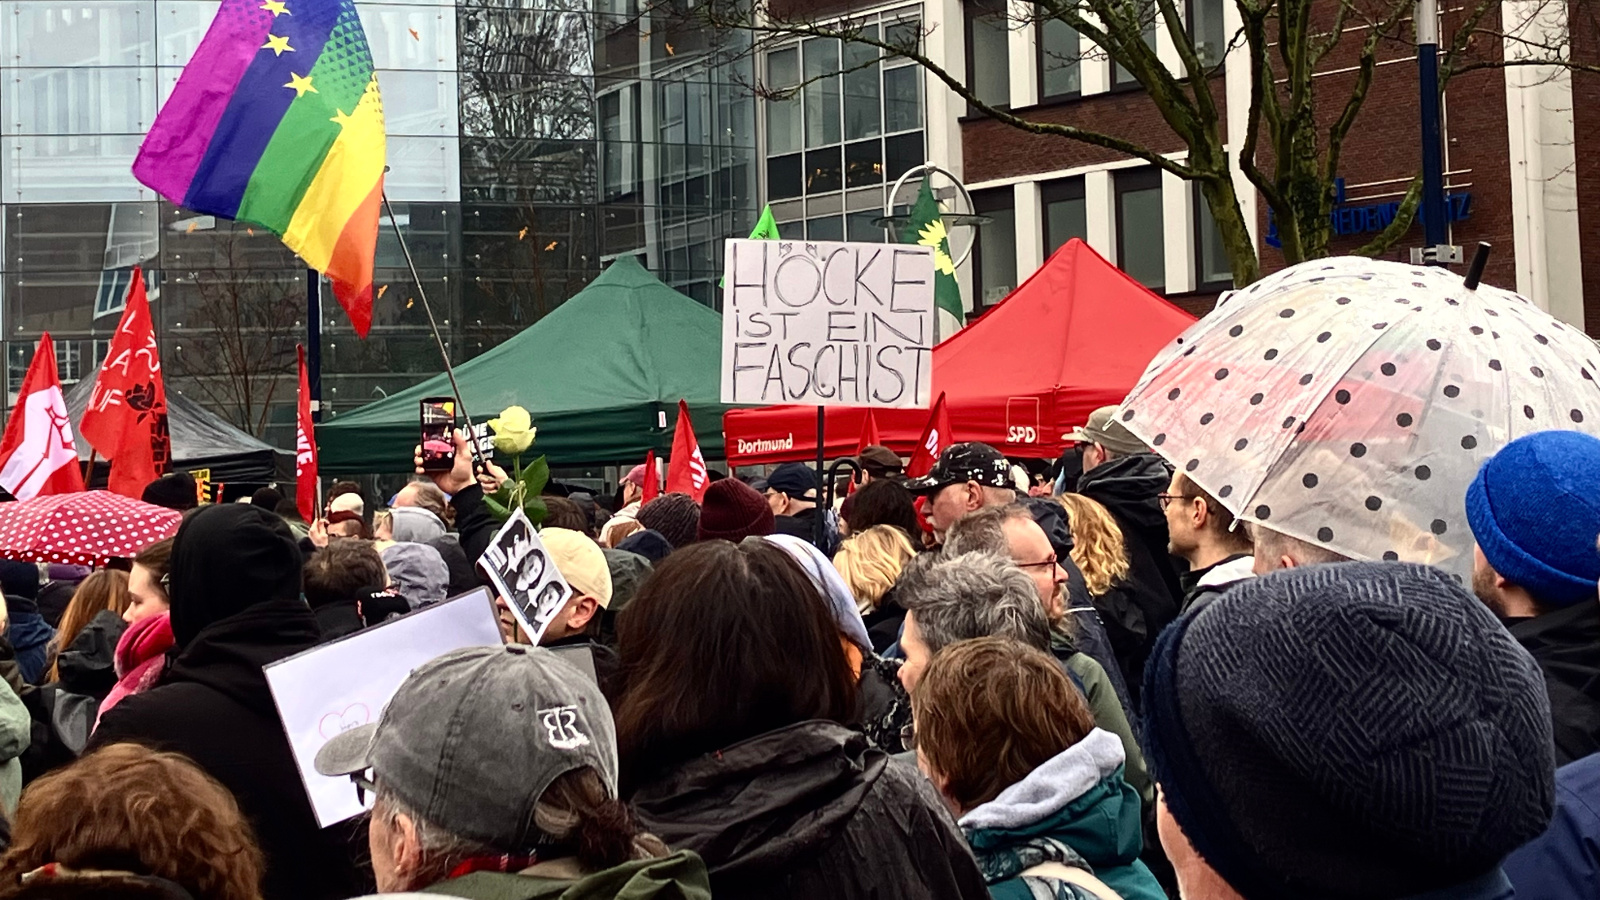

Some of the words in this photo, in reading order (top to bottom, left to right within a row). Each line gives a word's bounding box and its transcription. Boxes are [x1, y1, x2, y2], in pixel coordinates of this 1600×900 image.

[733, 242, 930, 313] HÖCKE
[827, 311, 924, 345] EIN
[732, 342, 932, 405] FASCHIST
[737, 432, 793, 454] Dortmund
[1007, 426, 1036, 443] SPD
